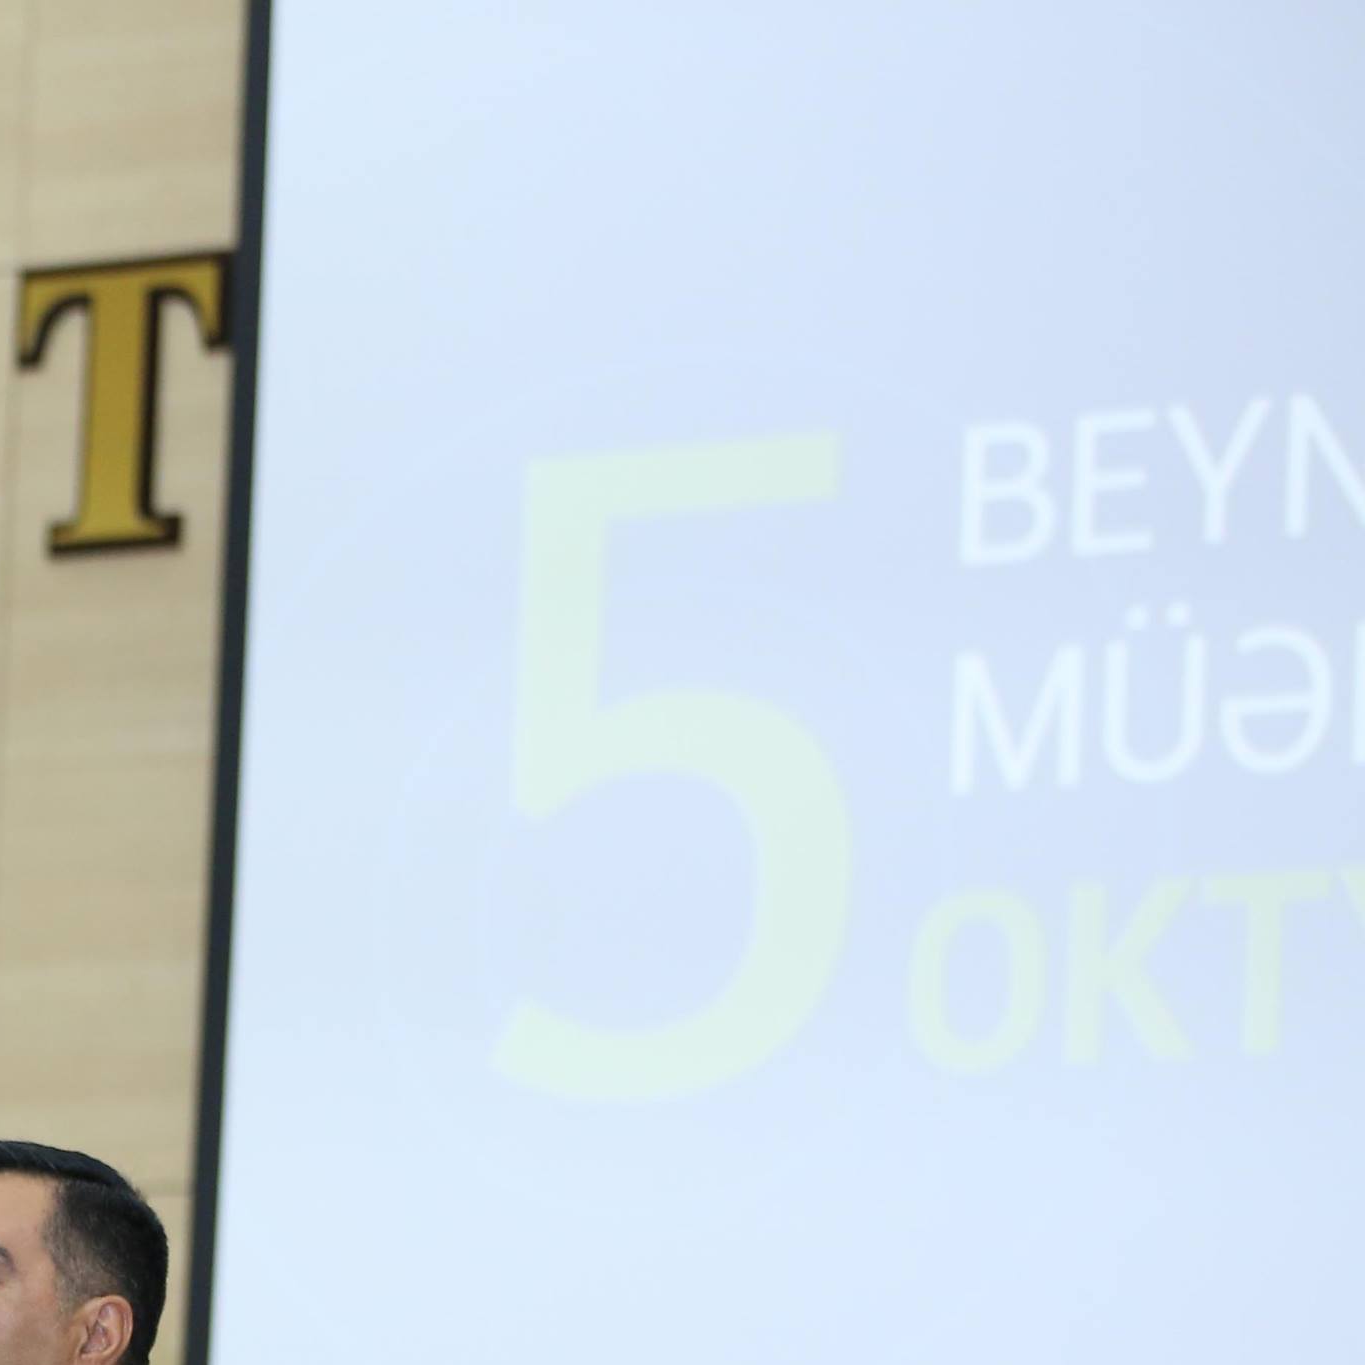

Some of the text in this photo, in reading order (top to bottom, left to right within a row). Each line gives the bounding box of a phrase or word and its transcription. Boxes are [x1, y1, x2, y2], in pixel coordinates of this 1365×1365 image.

[15, 248, 235, 559] T
[488, 427, 854, 1102] 5
[949, 600, 1365, 797] MÜƏ
[907, 864, 1365, 1075] OKT
